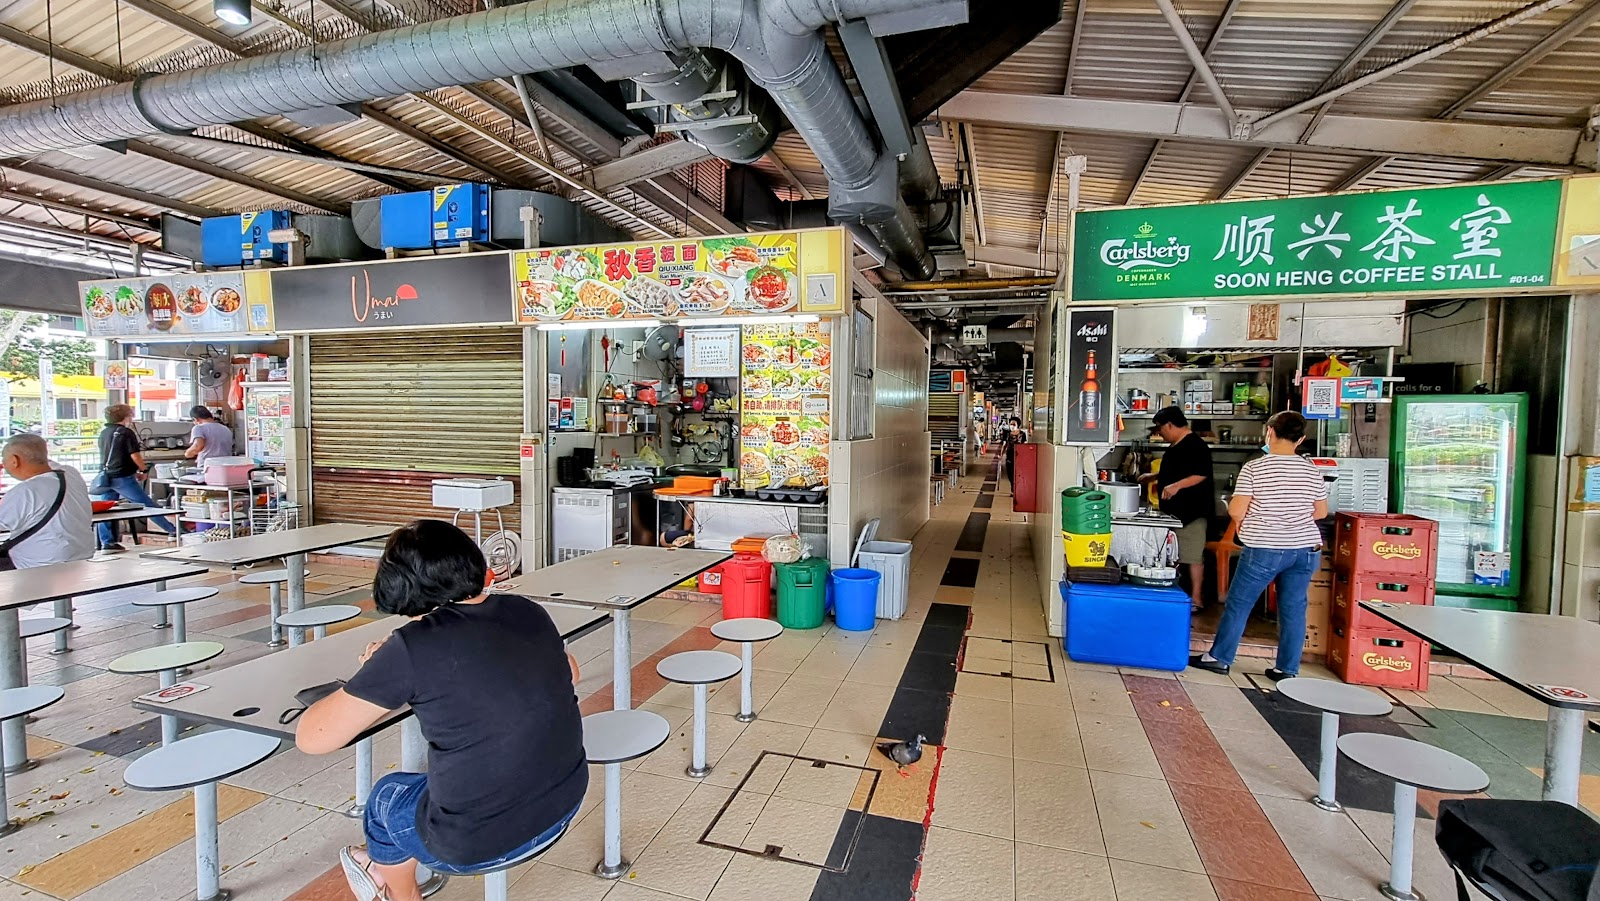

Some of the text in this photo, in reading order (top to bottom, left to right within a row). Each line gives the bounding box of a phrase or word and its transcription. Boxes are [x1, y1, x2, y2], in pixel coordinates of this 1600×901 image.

[1212, 193, 1512, 267] 顺兴茶室
[1100, 237, 1191, 269] Carlsberg
[1117, 272, 1171, 282] DENMARK
[1214, 262, 1504, 289] SOON HENG COFFEE STALL
[1509, 274, 1546, 285] #01-04
[352, 269, 400, 322] Umai
[373, 311, 394, 320] うまい
[1076, 323, 1108, 337] Asahi
[1395, 384, 1417, 392] calls
[1419, 383, 1433, 392] for
[1372, 540, 1422, 559] Carlsberg
[1362, 652, 1413, 671] Carlsberg
